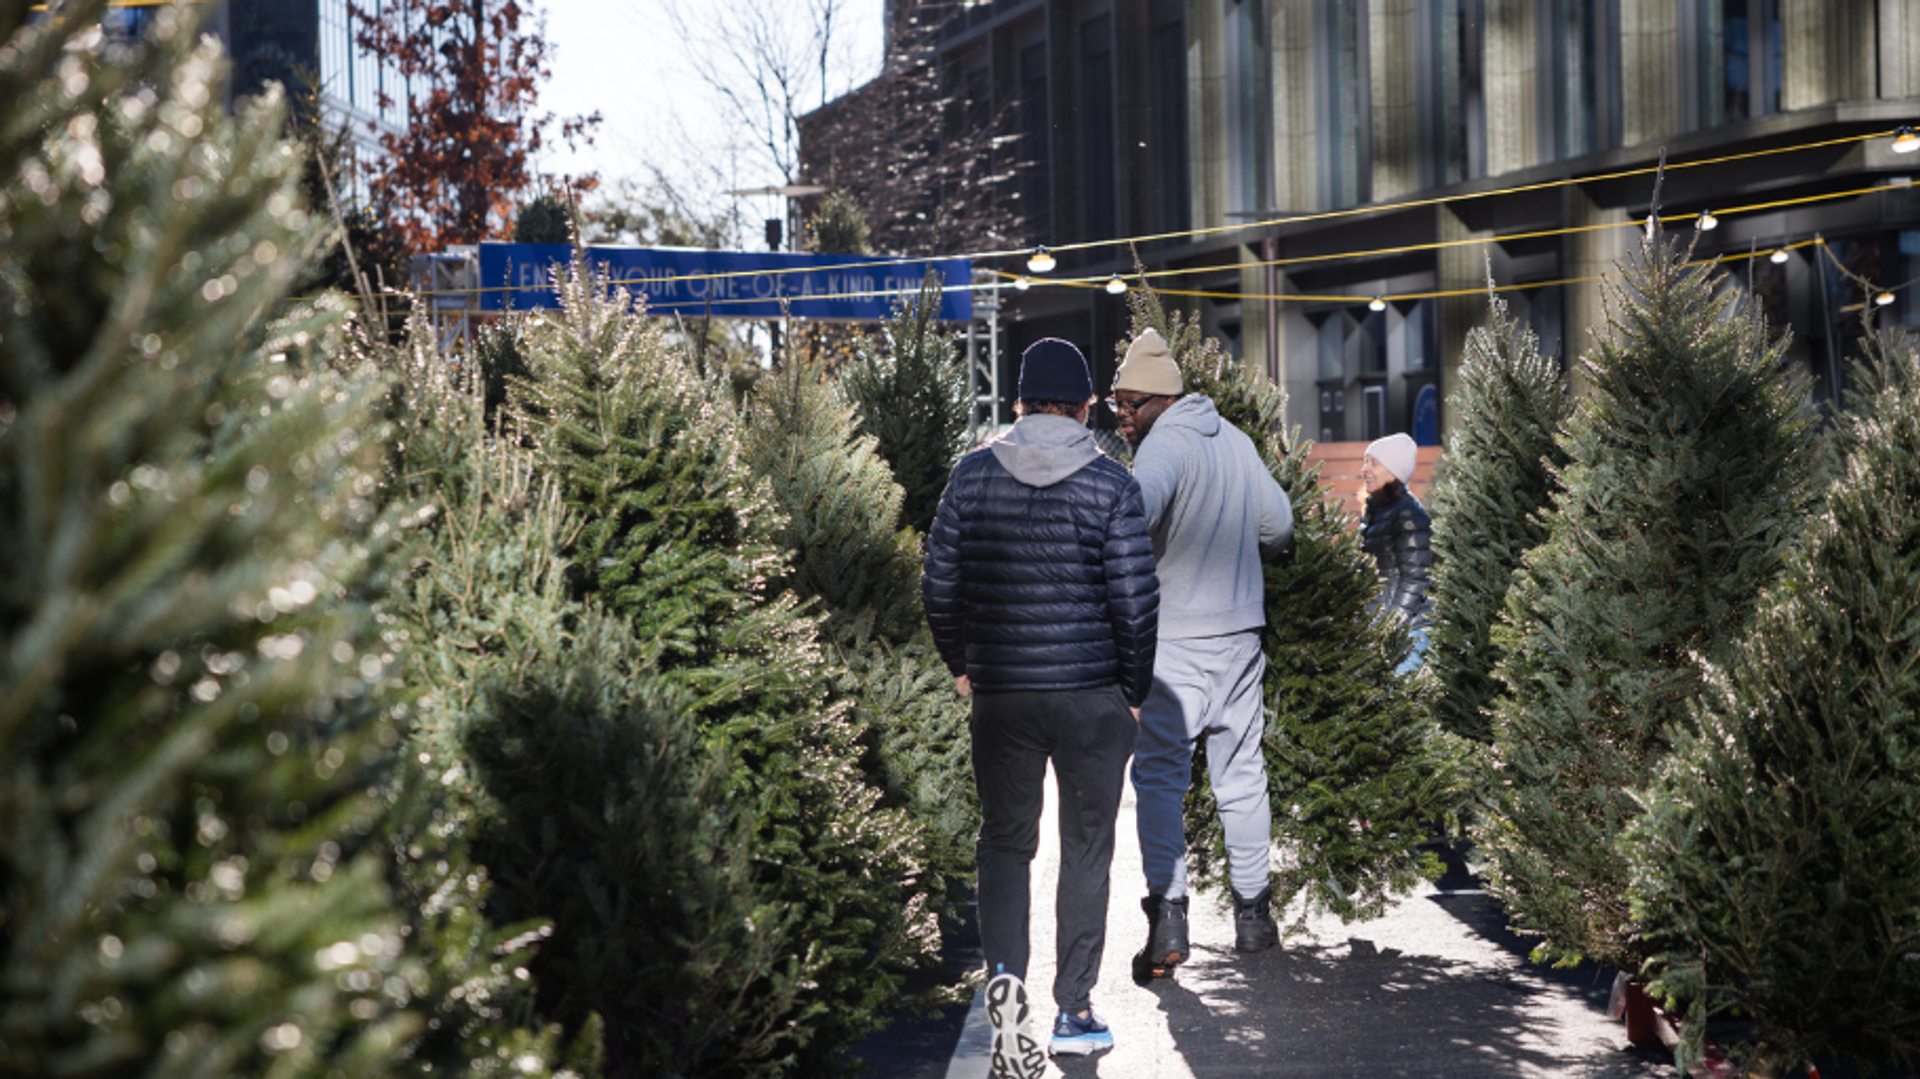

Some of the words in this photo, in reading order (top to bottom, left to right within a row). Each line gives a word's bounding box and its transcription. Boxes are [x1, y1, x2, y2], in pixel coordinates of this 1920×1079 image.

[611, 265, 677, 297] YOUR
[686, 267, 875, 303] ONE-OF-A-KIND
[884, 275, 930, 304] FIN
